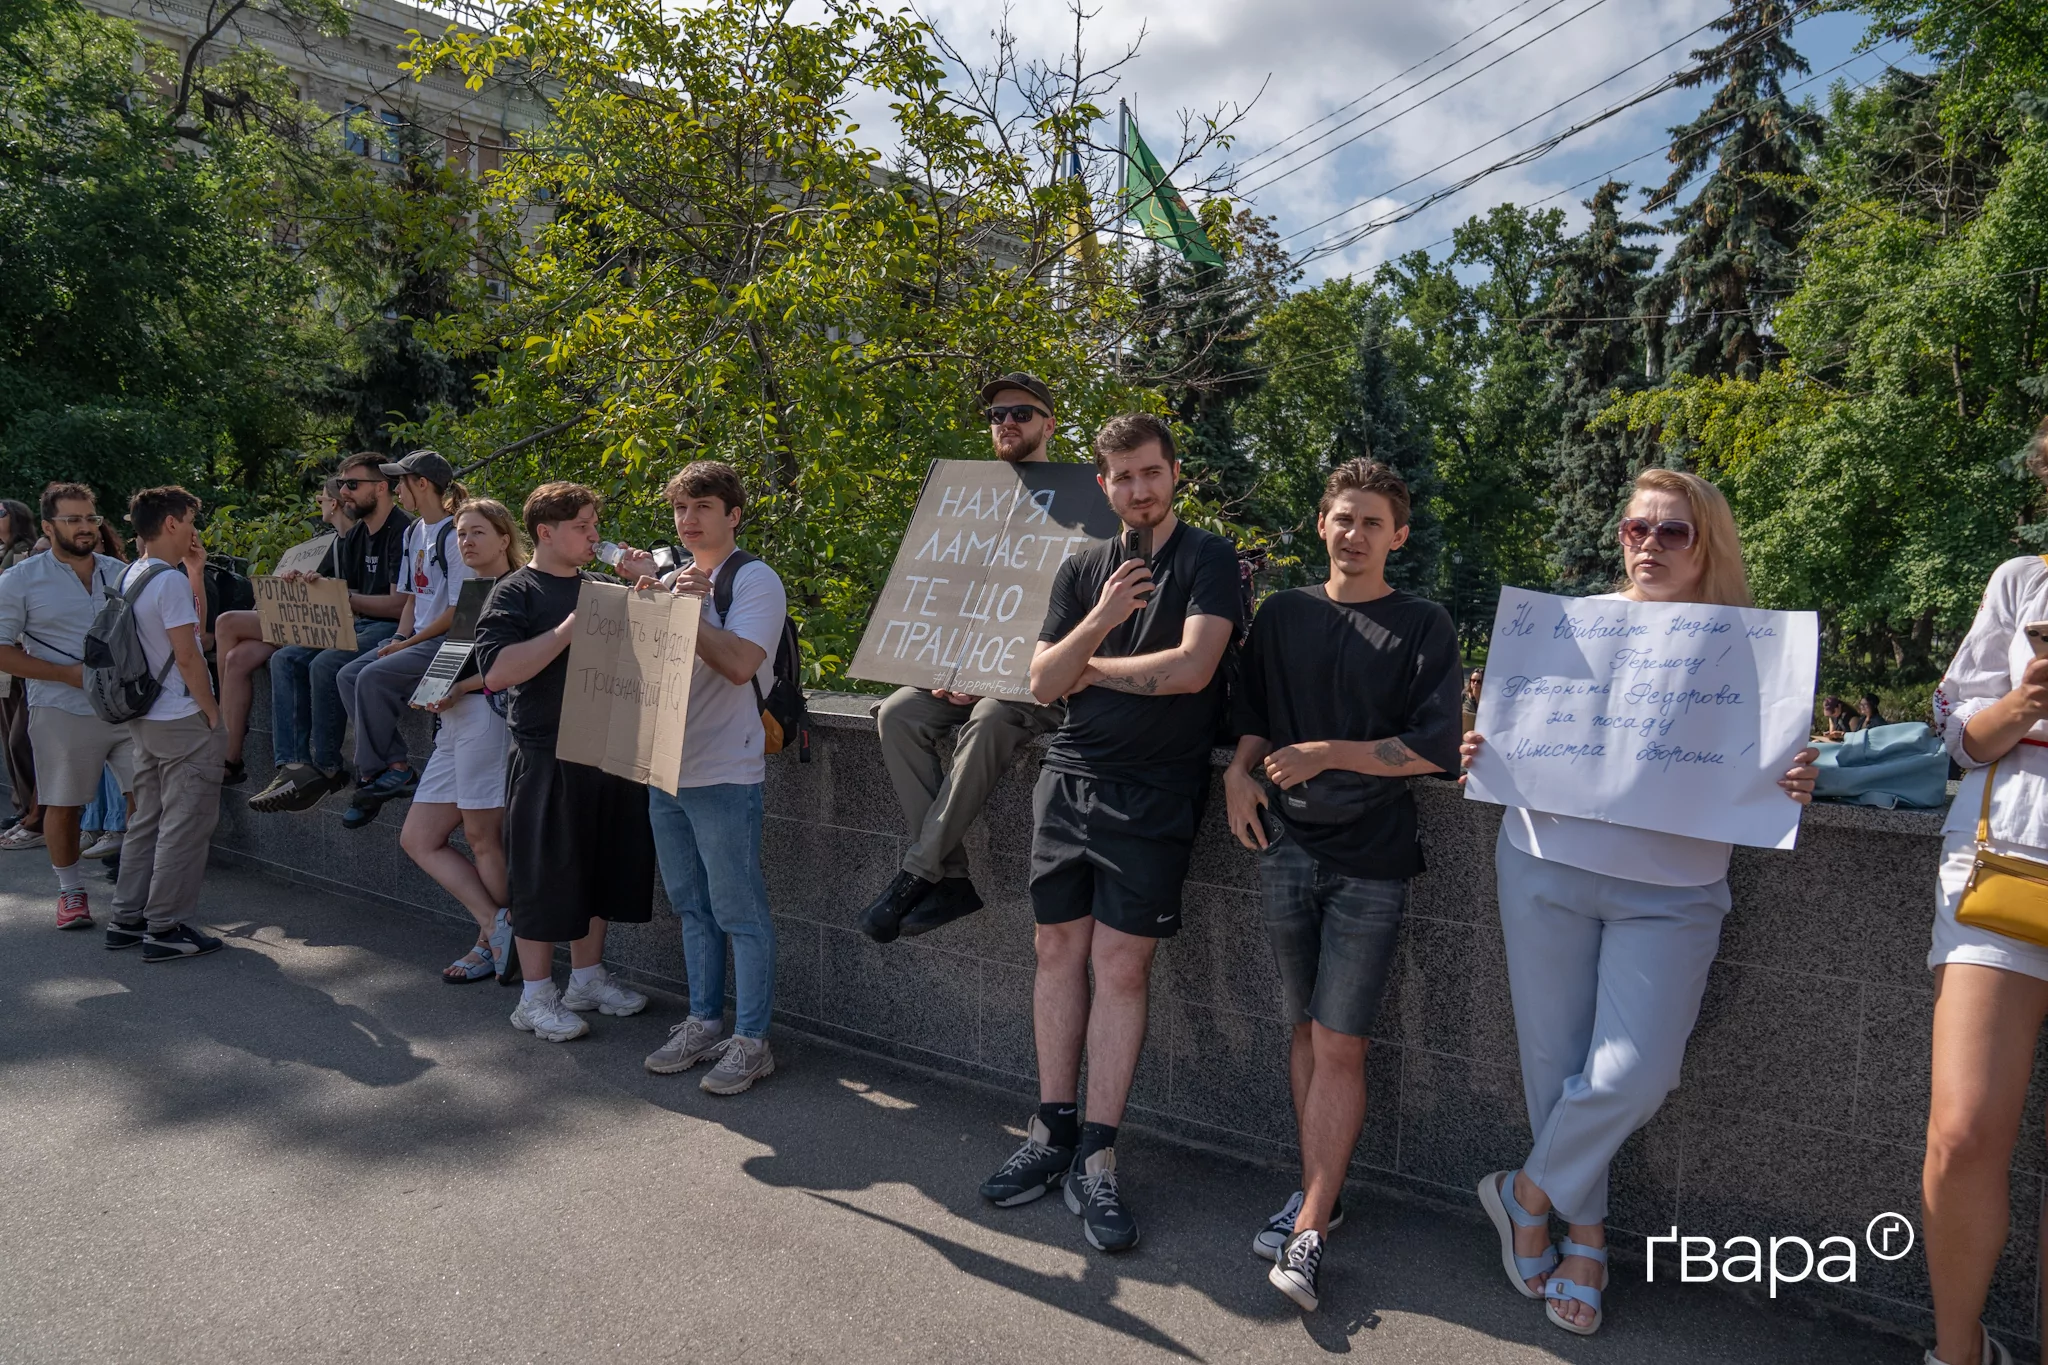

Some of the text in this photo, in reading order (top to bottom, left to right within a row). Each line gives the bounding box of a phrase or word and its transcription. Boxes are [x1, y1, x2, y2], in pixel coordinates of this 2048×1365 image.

[902, 575, 1024, 626] ТЕ ЩО
[270, 622, 338, 649] НЕ В ТИЛУ
[1501, 601, 1535, 637] Не
[1553, 613, 1649, 640] вбивайте
[1745, 624, 1777, 640] на
[876, 619, 1026, 676] ПРАЦЮЄ
[1501, 675, 1744, 717] Поверніть Федорова
[1546, 711, 1676, 738] на посаду
[1506, 737, 1607, 765] Міністра
